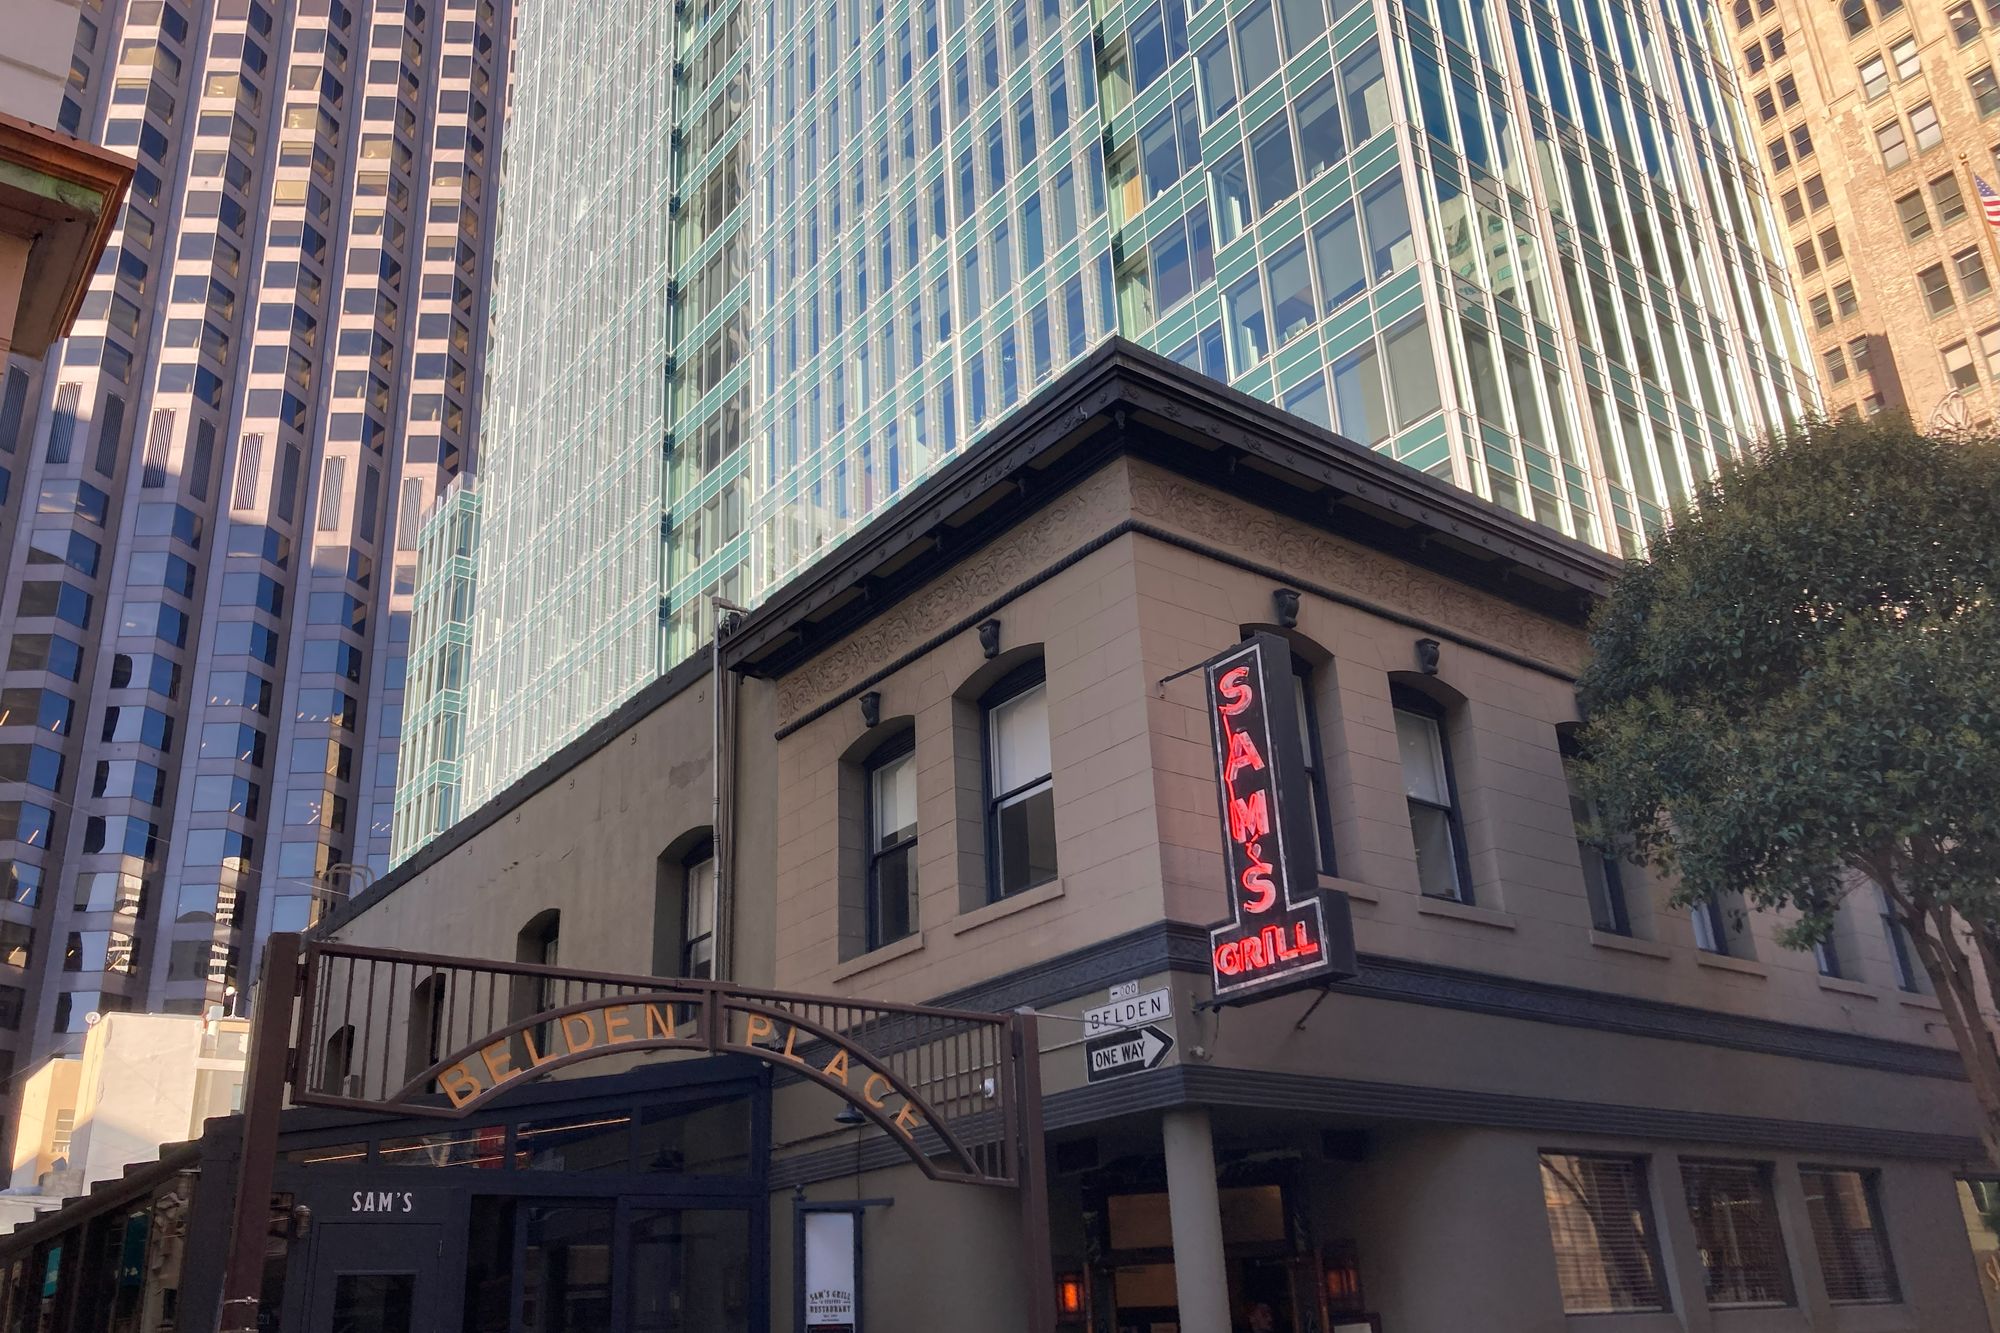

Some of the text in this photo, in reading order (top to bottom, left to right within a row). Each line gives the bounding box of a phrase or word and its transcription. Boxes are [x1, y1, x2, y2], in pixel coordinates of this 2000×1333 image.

[1215, 921, 1318, 976] GRILL
[1091, 996, 1161, 1030] BELDEN
[437, 1002, 924, 1140] BELDEN PLACE
[1095, 1040, 1146, 1069] ONE WAY
[351, 1191, 413, 1213] SAM'S
